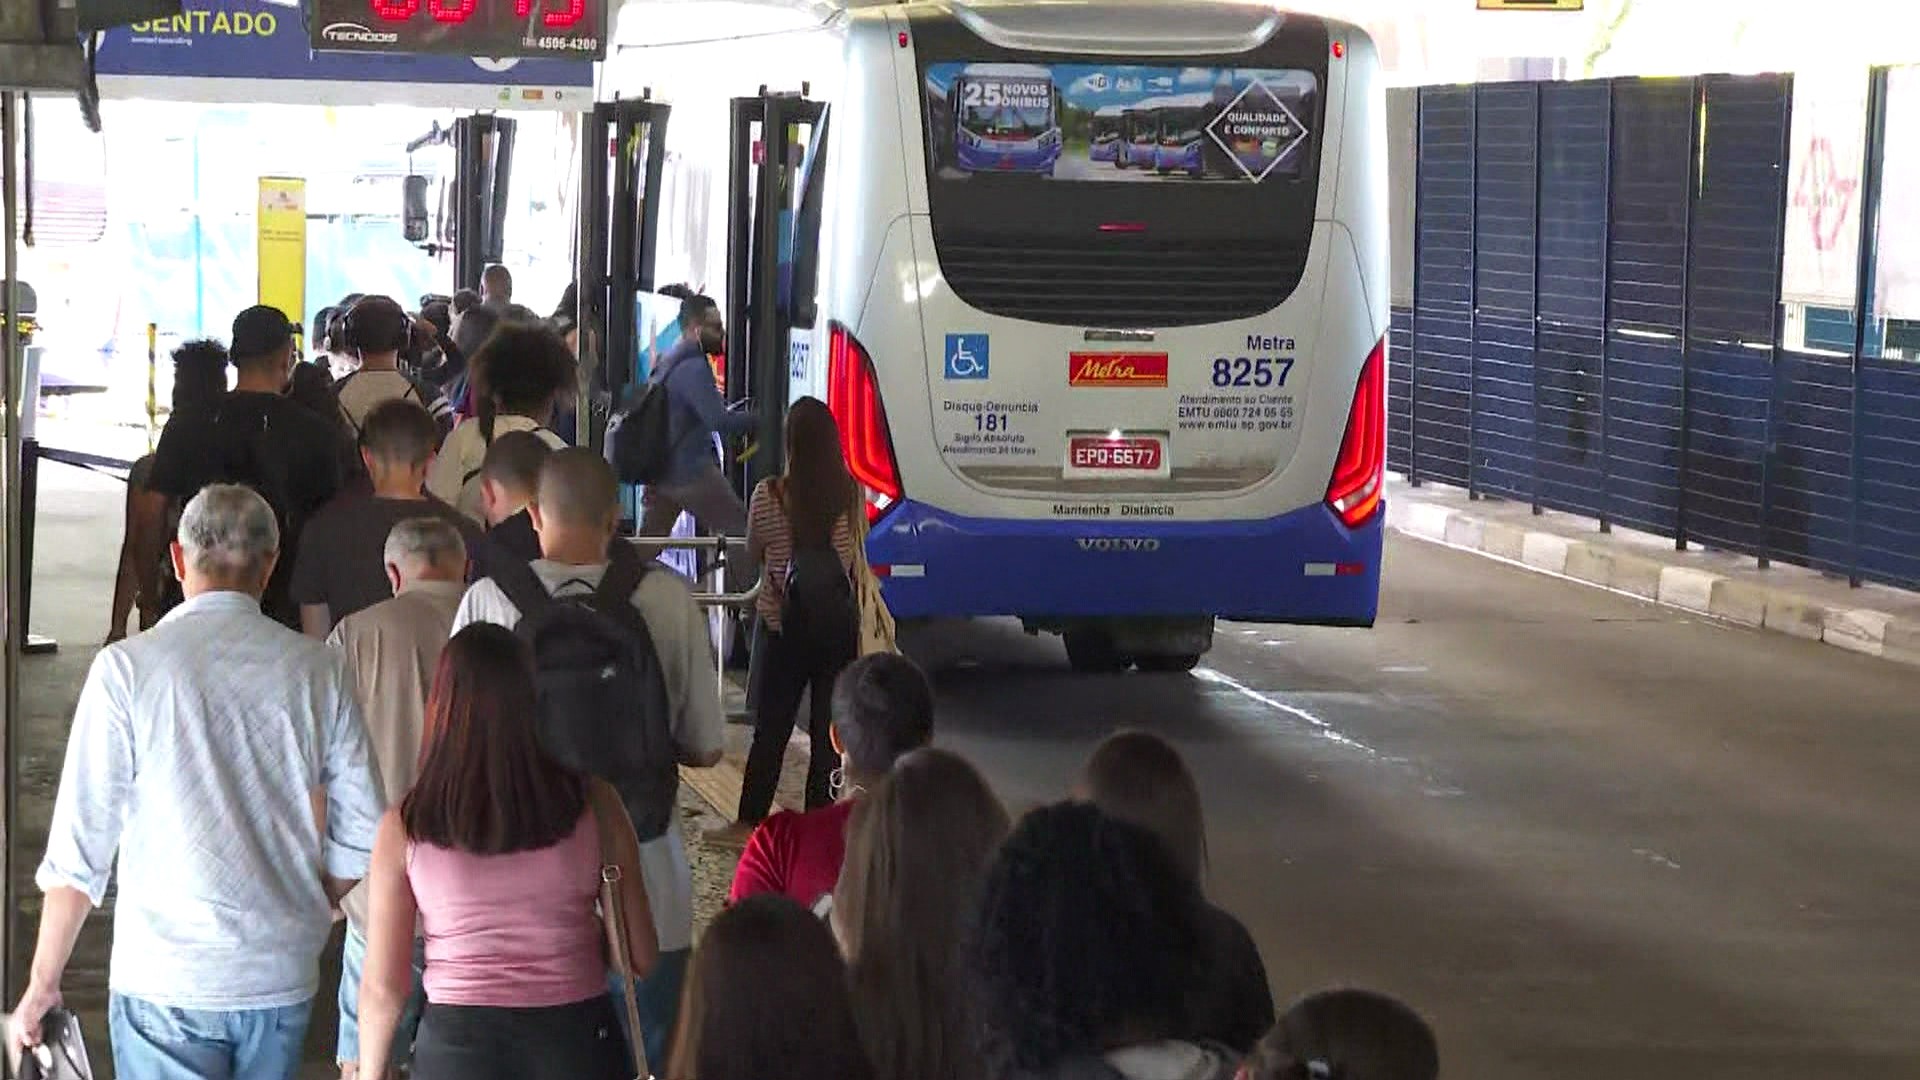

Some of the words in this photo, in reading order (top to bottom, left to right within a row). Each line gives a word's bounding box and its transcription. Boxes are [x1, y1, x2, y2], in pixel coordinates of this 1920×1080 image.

[964, 83, 1001, 106] 25
[1003, 84, 1048, 96] NOVOS
[1227, 112, 1287, 123] QUALIDADE
[1224, 125, 1232, 135] E
[1233, 125, 1290, 137] CONFORTO
[1247, 335, 1295, 351] Metra
[1072, 355, 1152, 383] Metra
[1212, 357, 1295, 387] 8257
[1178, 407, 1210, 418] EMTU
[1242, 407, 1261, 418] 724
[975, 414, 1007, 431] 181
[1053, 504, 1110, 516] Mantenha
[1075, 538, 1160, 551] VOLVO
